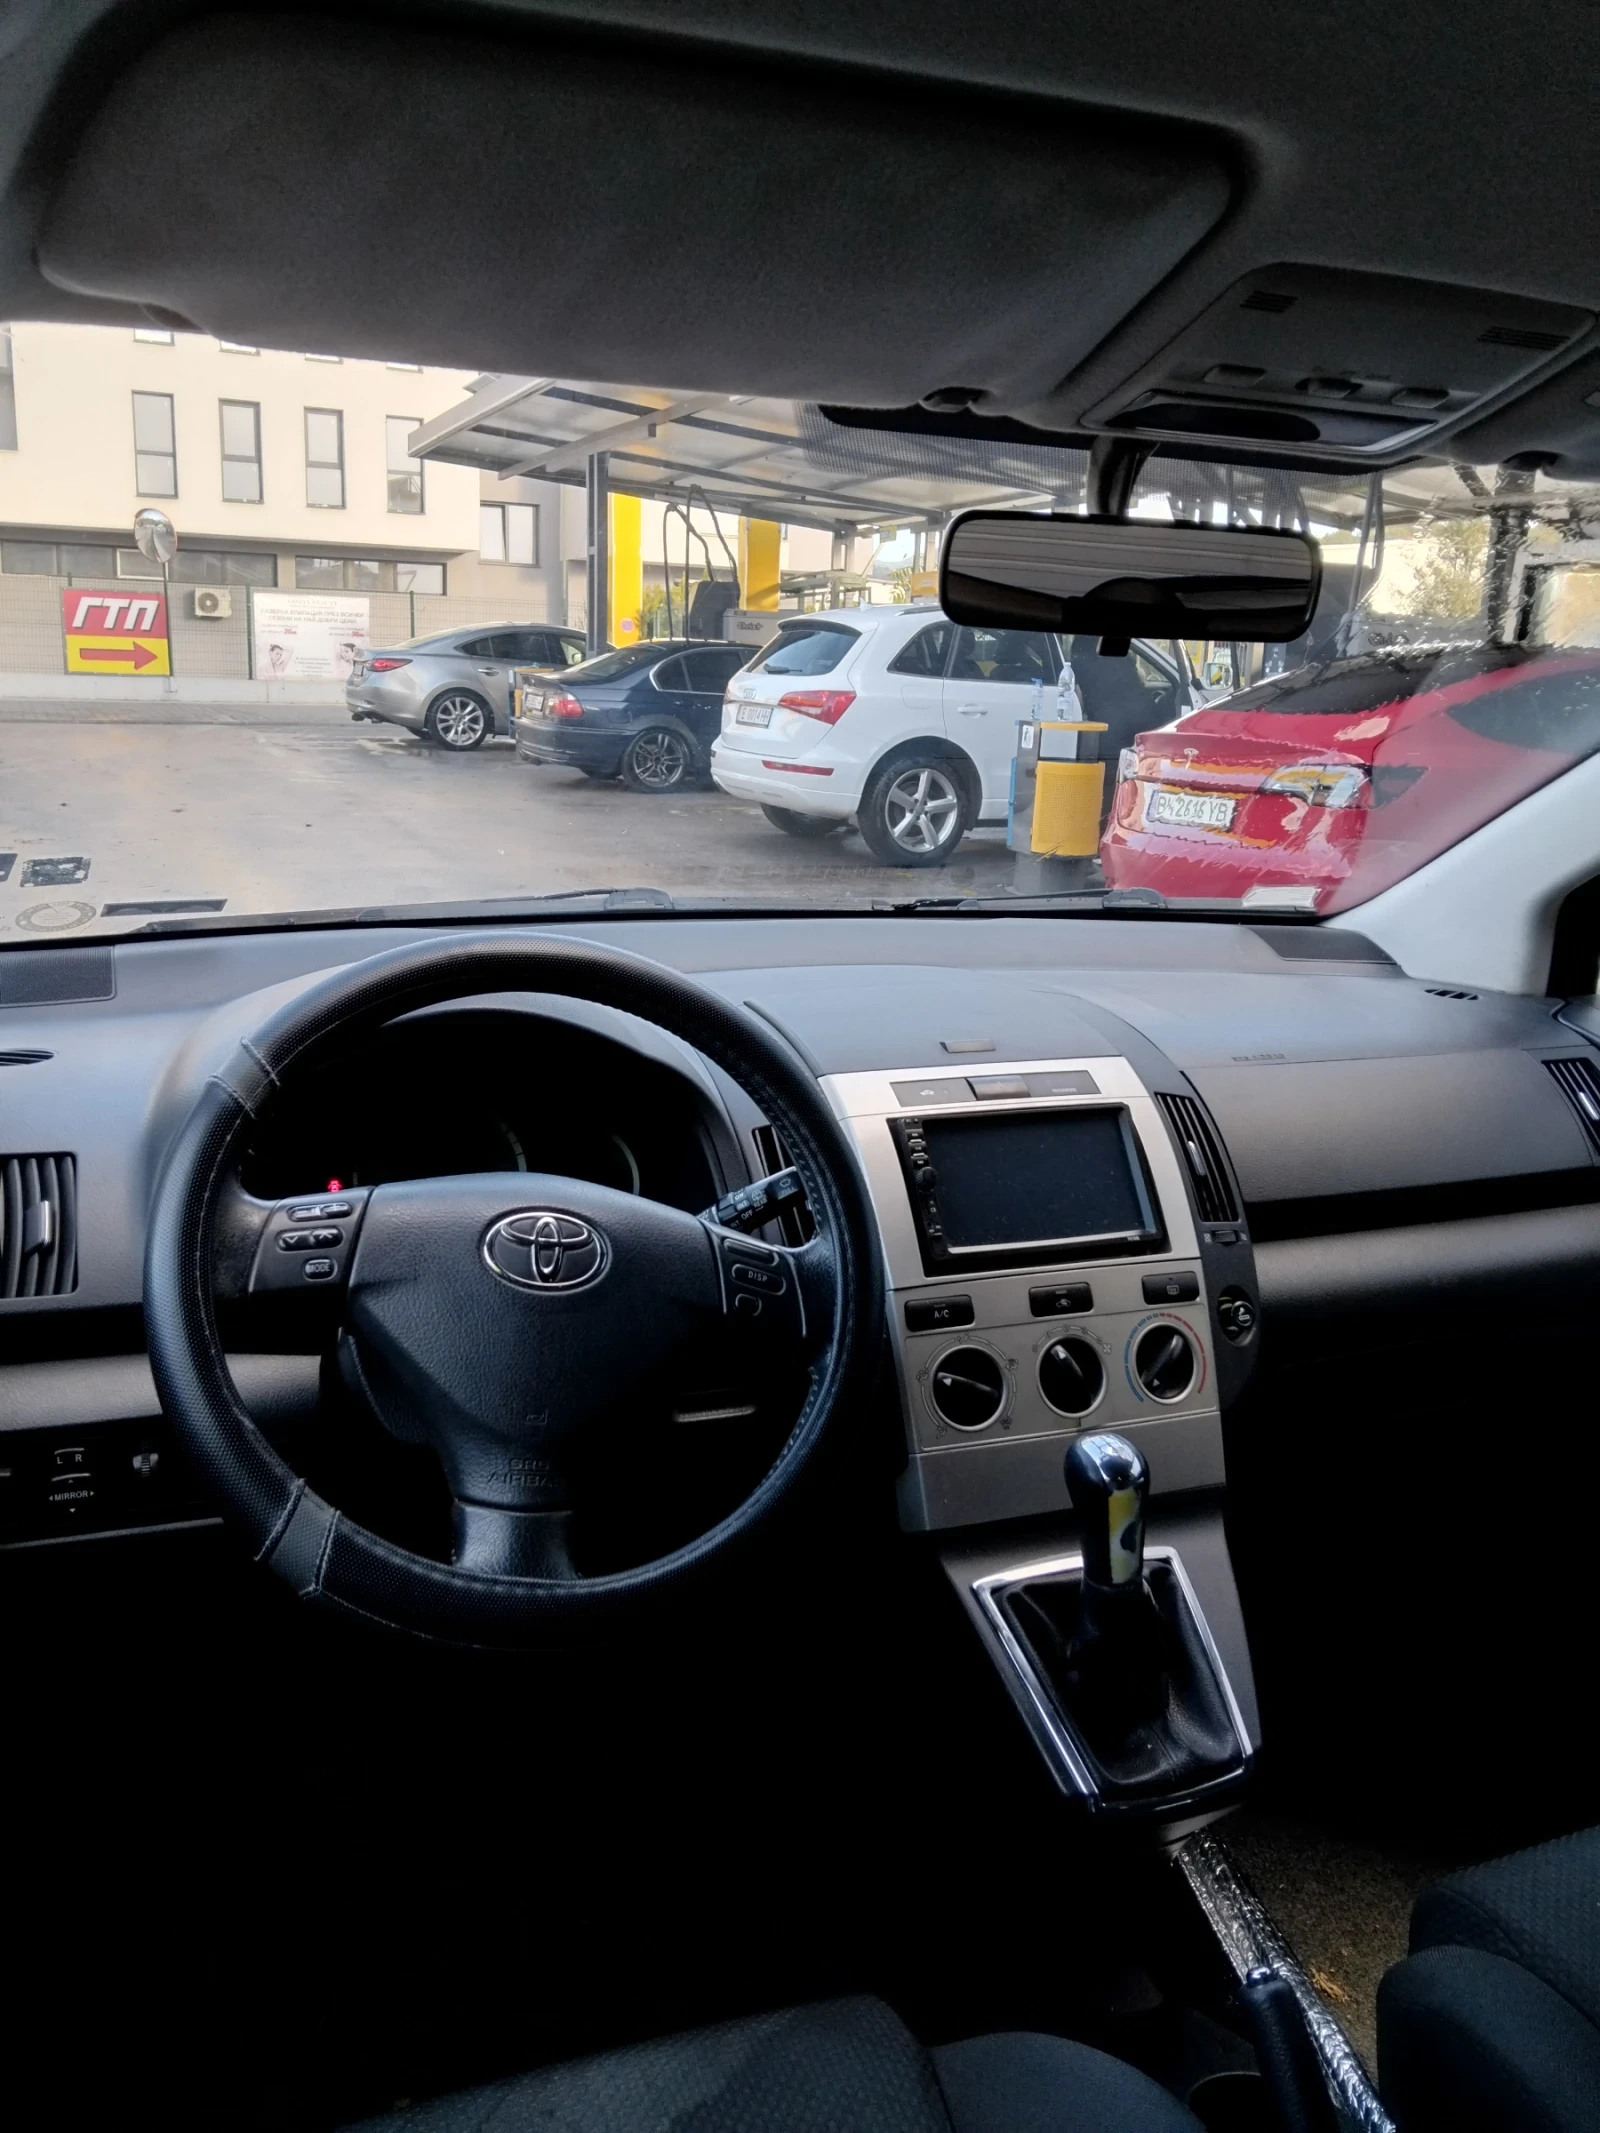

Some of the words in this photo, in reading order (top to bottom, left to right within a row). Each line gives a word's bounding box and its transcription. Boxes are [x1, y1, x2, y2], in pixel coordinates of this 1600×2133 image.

[72, 597, 159, 631] ГТП
[741, 1209, 753, 1220] OFF
[748, 1270, 768, 1282] DISP
[934, 1309, 950, 1319] A/C
[56, 1456, 63, 1464] L
[75, 1454, 82, 1462] R
[54, 1490, 89, 1501] MIRROR
